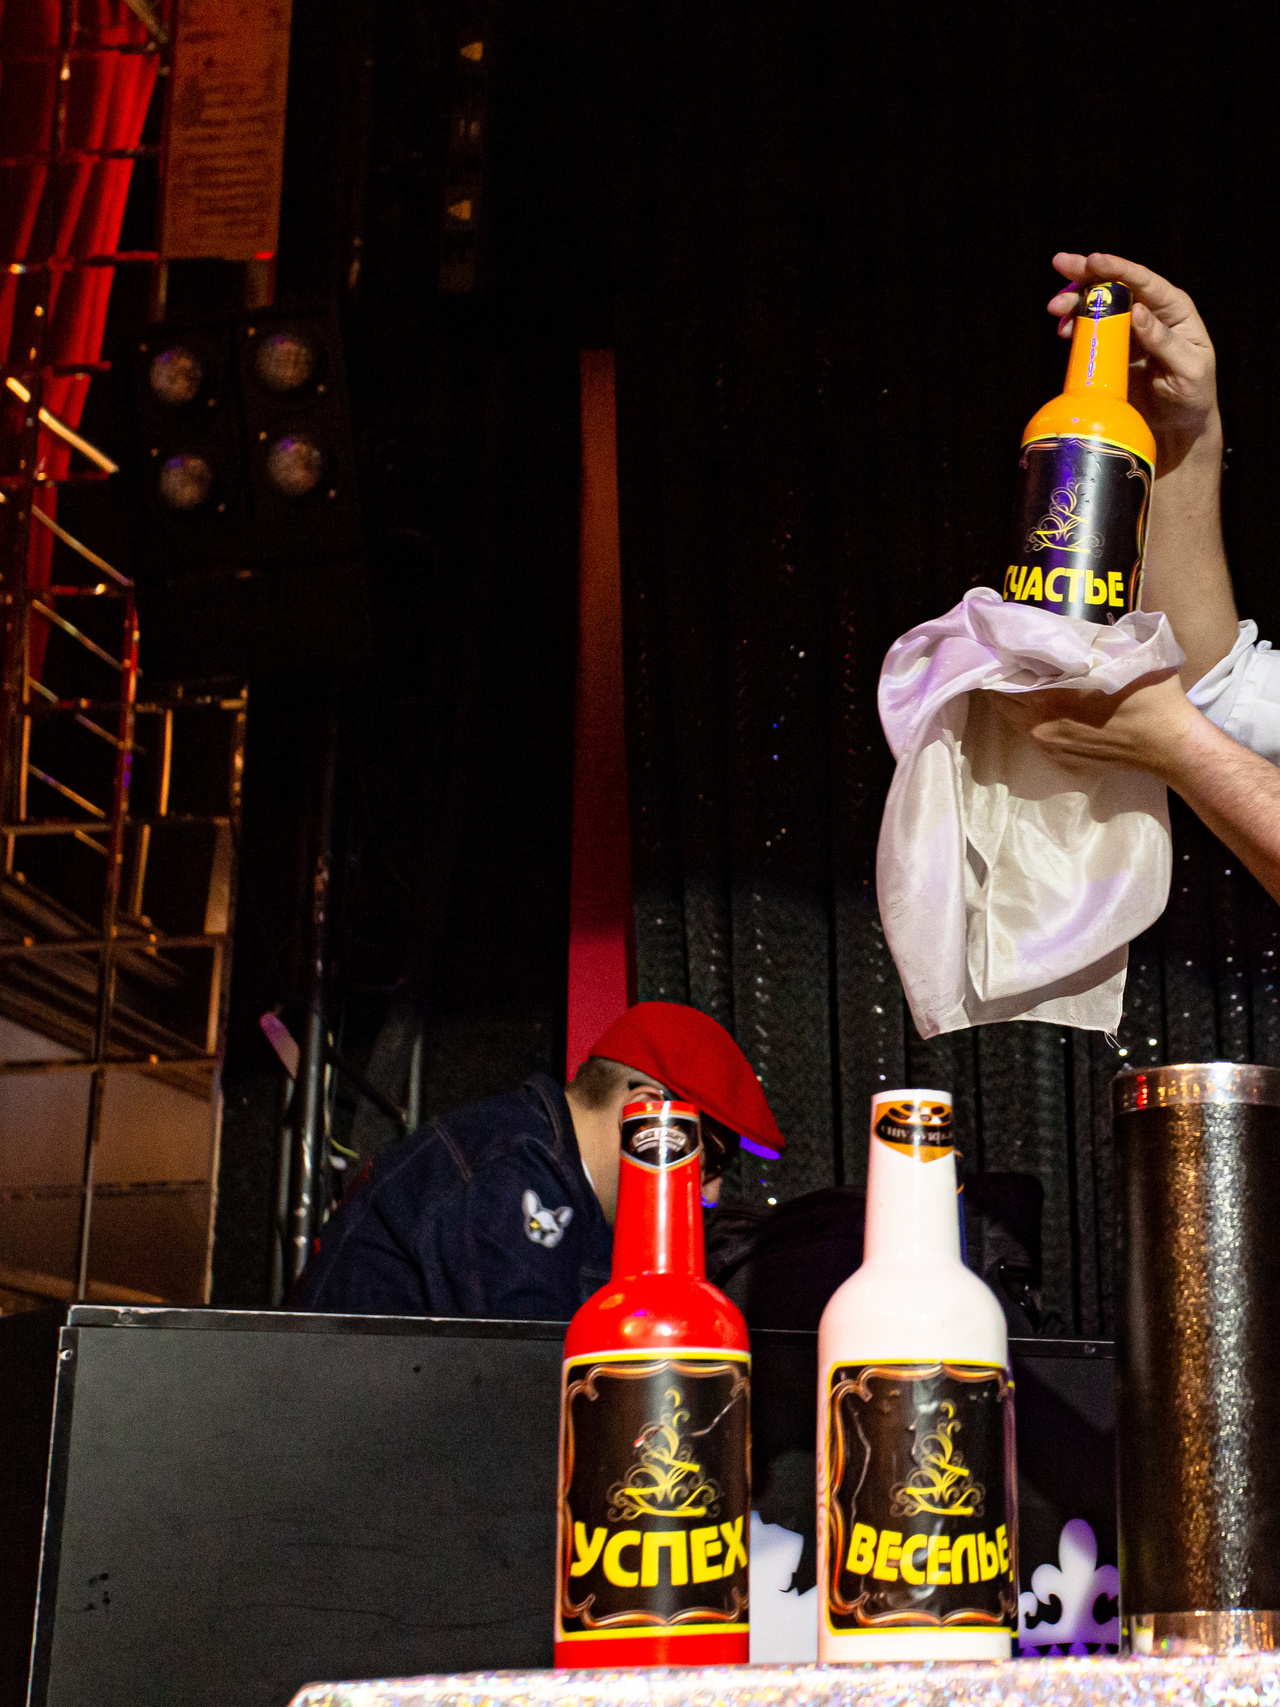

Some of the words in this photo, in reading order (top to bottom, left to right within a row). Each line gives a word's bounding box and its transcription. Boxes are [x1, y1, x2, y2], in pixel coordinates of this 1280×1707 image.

[1003, 565, 1124, 607] СЧАСТЬЕ
[570, 1515, 748, 1588] УСПЕХ
[846, 1522, 1009, 1585] ВЕСЕЛЬЕ
